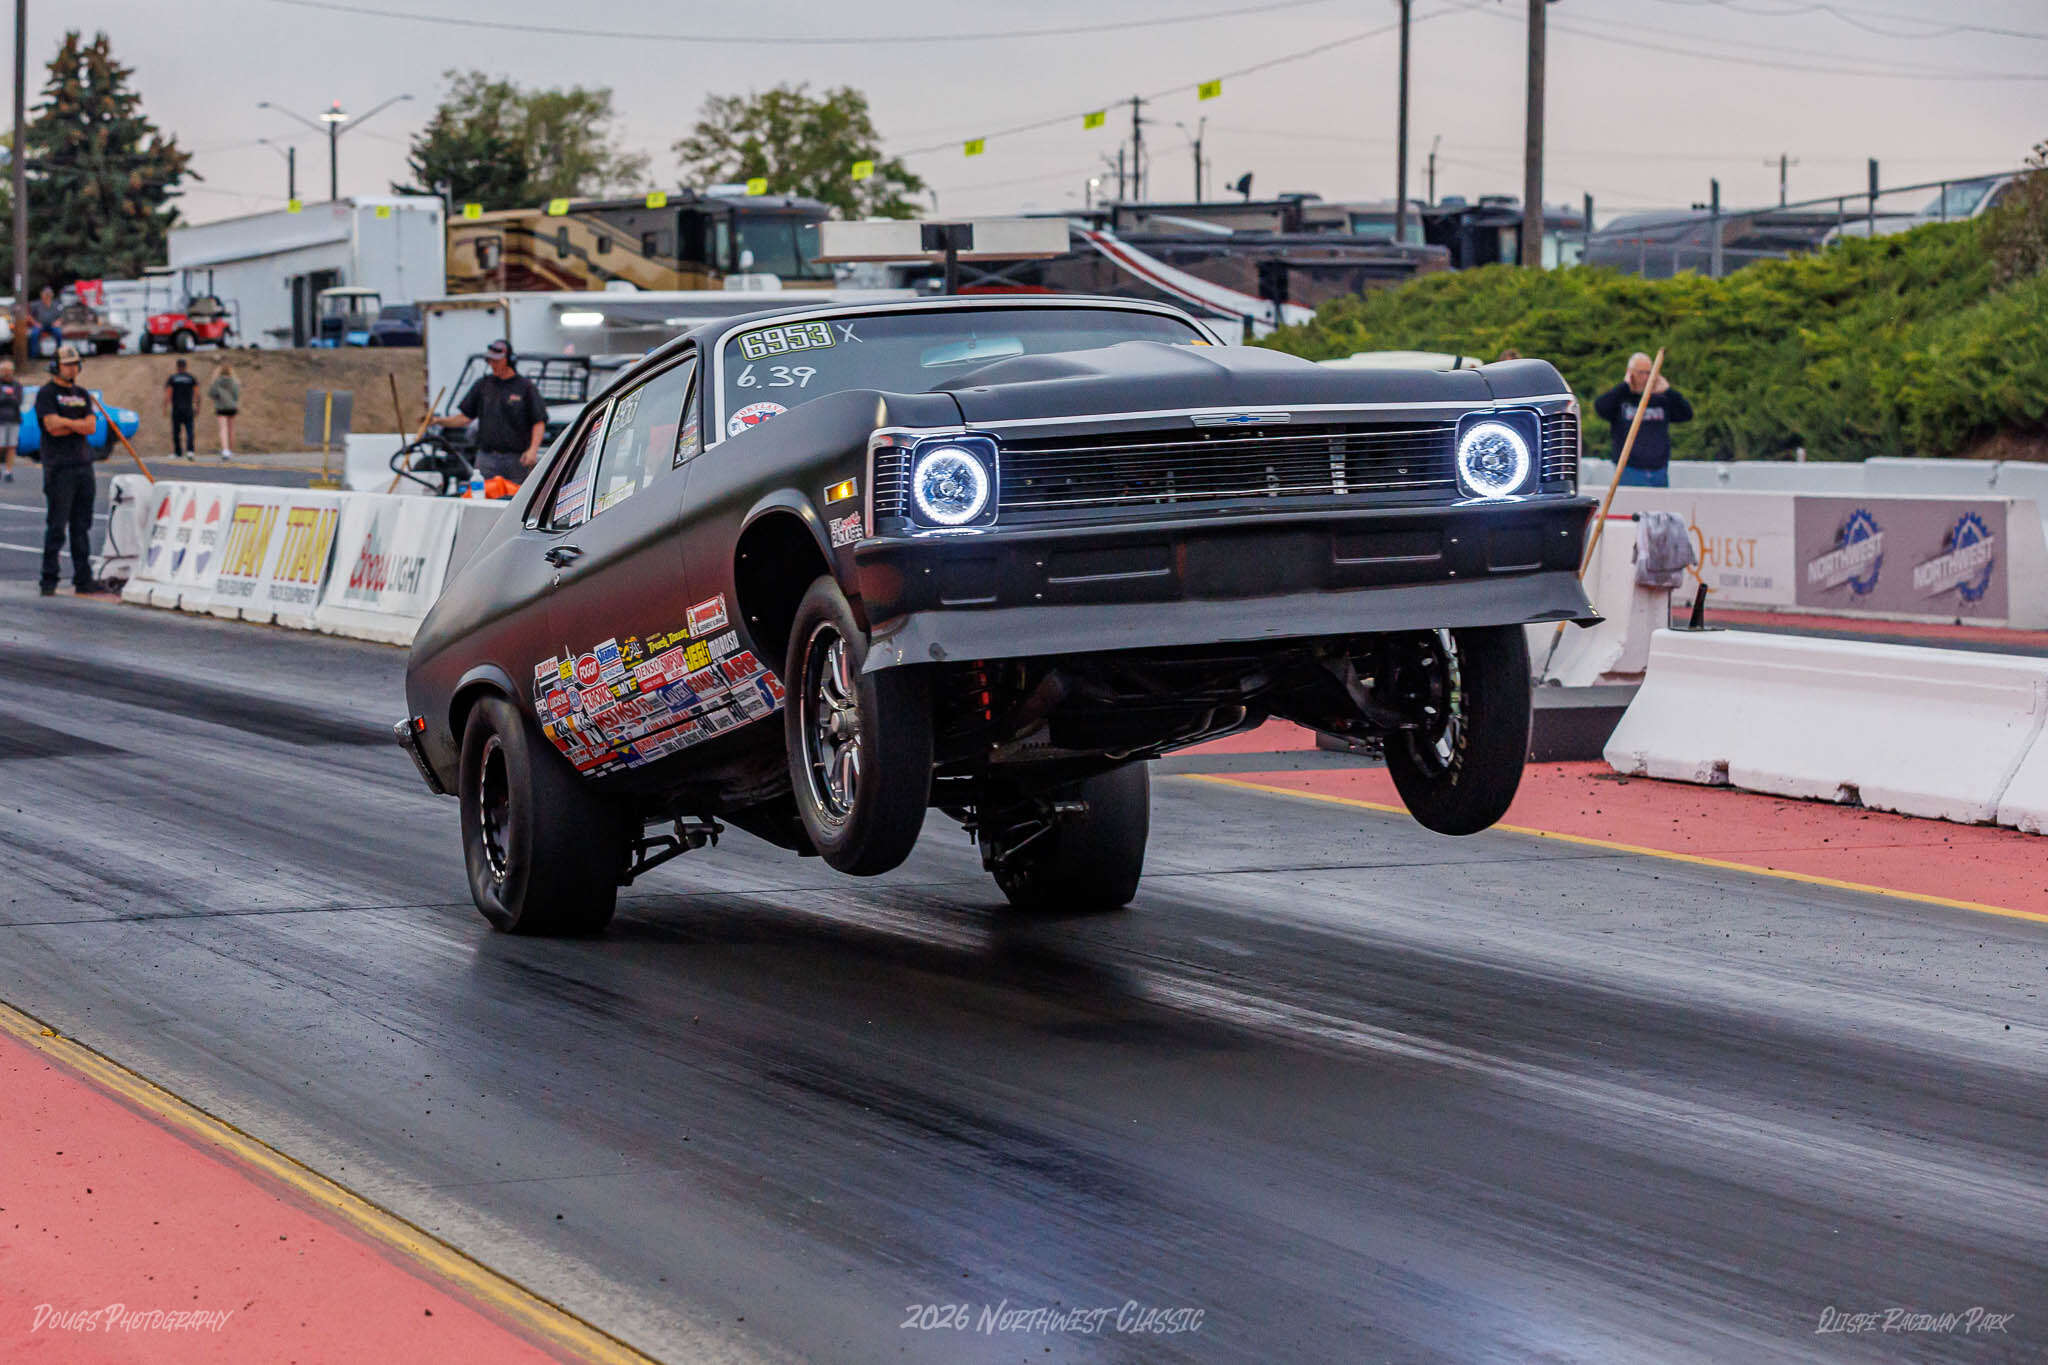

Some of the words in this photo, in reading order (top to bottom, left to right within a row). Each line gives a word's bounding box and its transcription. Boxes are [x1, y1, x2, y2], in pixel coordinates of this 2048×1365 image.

[740, 321, 834, 360] 6953
[736, 364, 817, 389] 6.39
[1808, 534, 1882, 584] NORTHWEST
[1913, 538, 1992, 590] NORTHWEST
[635, 660, 661, 680] DENSO
[722, 651, 759, 682] ARP
